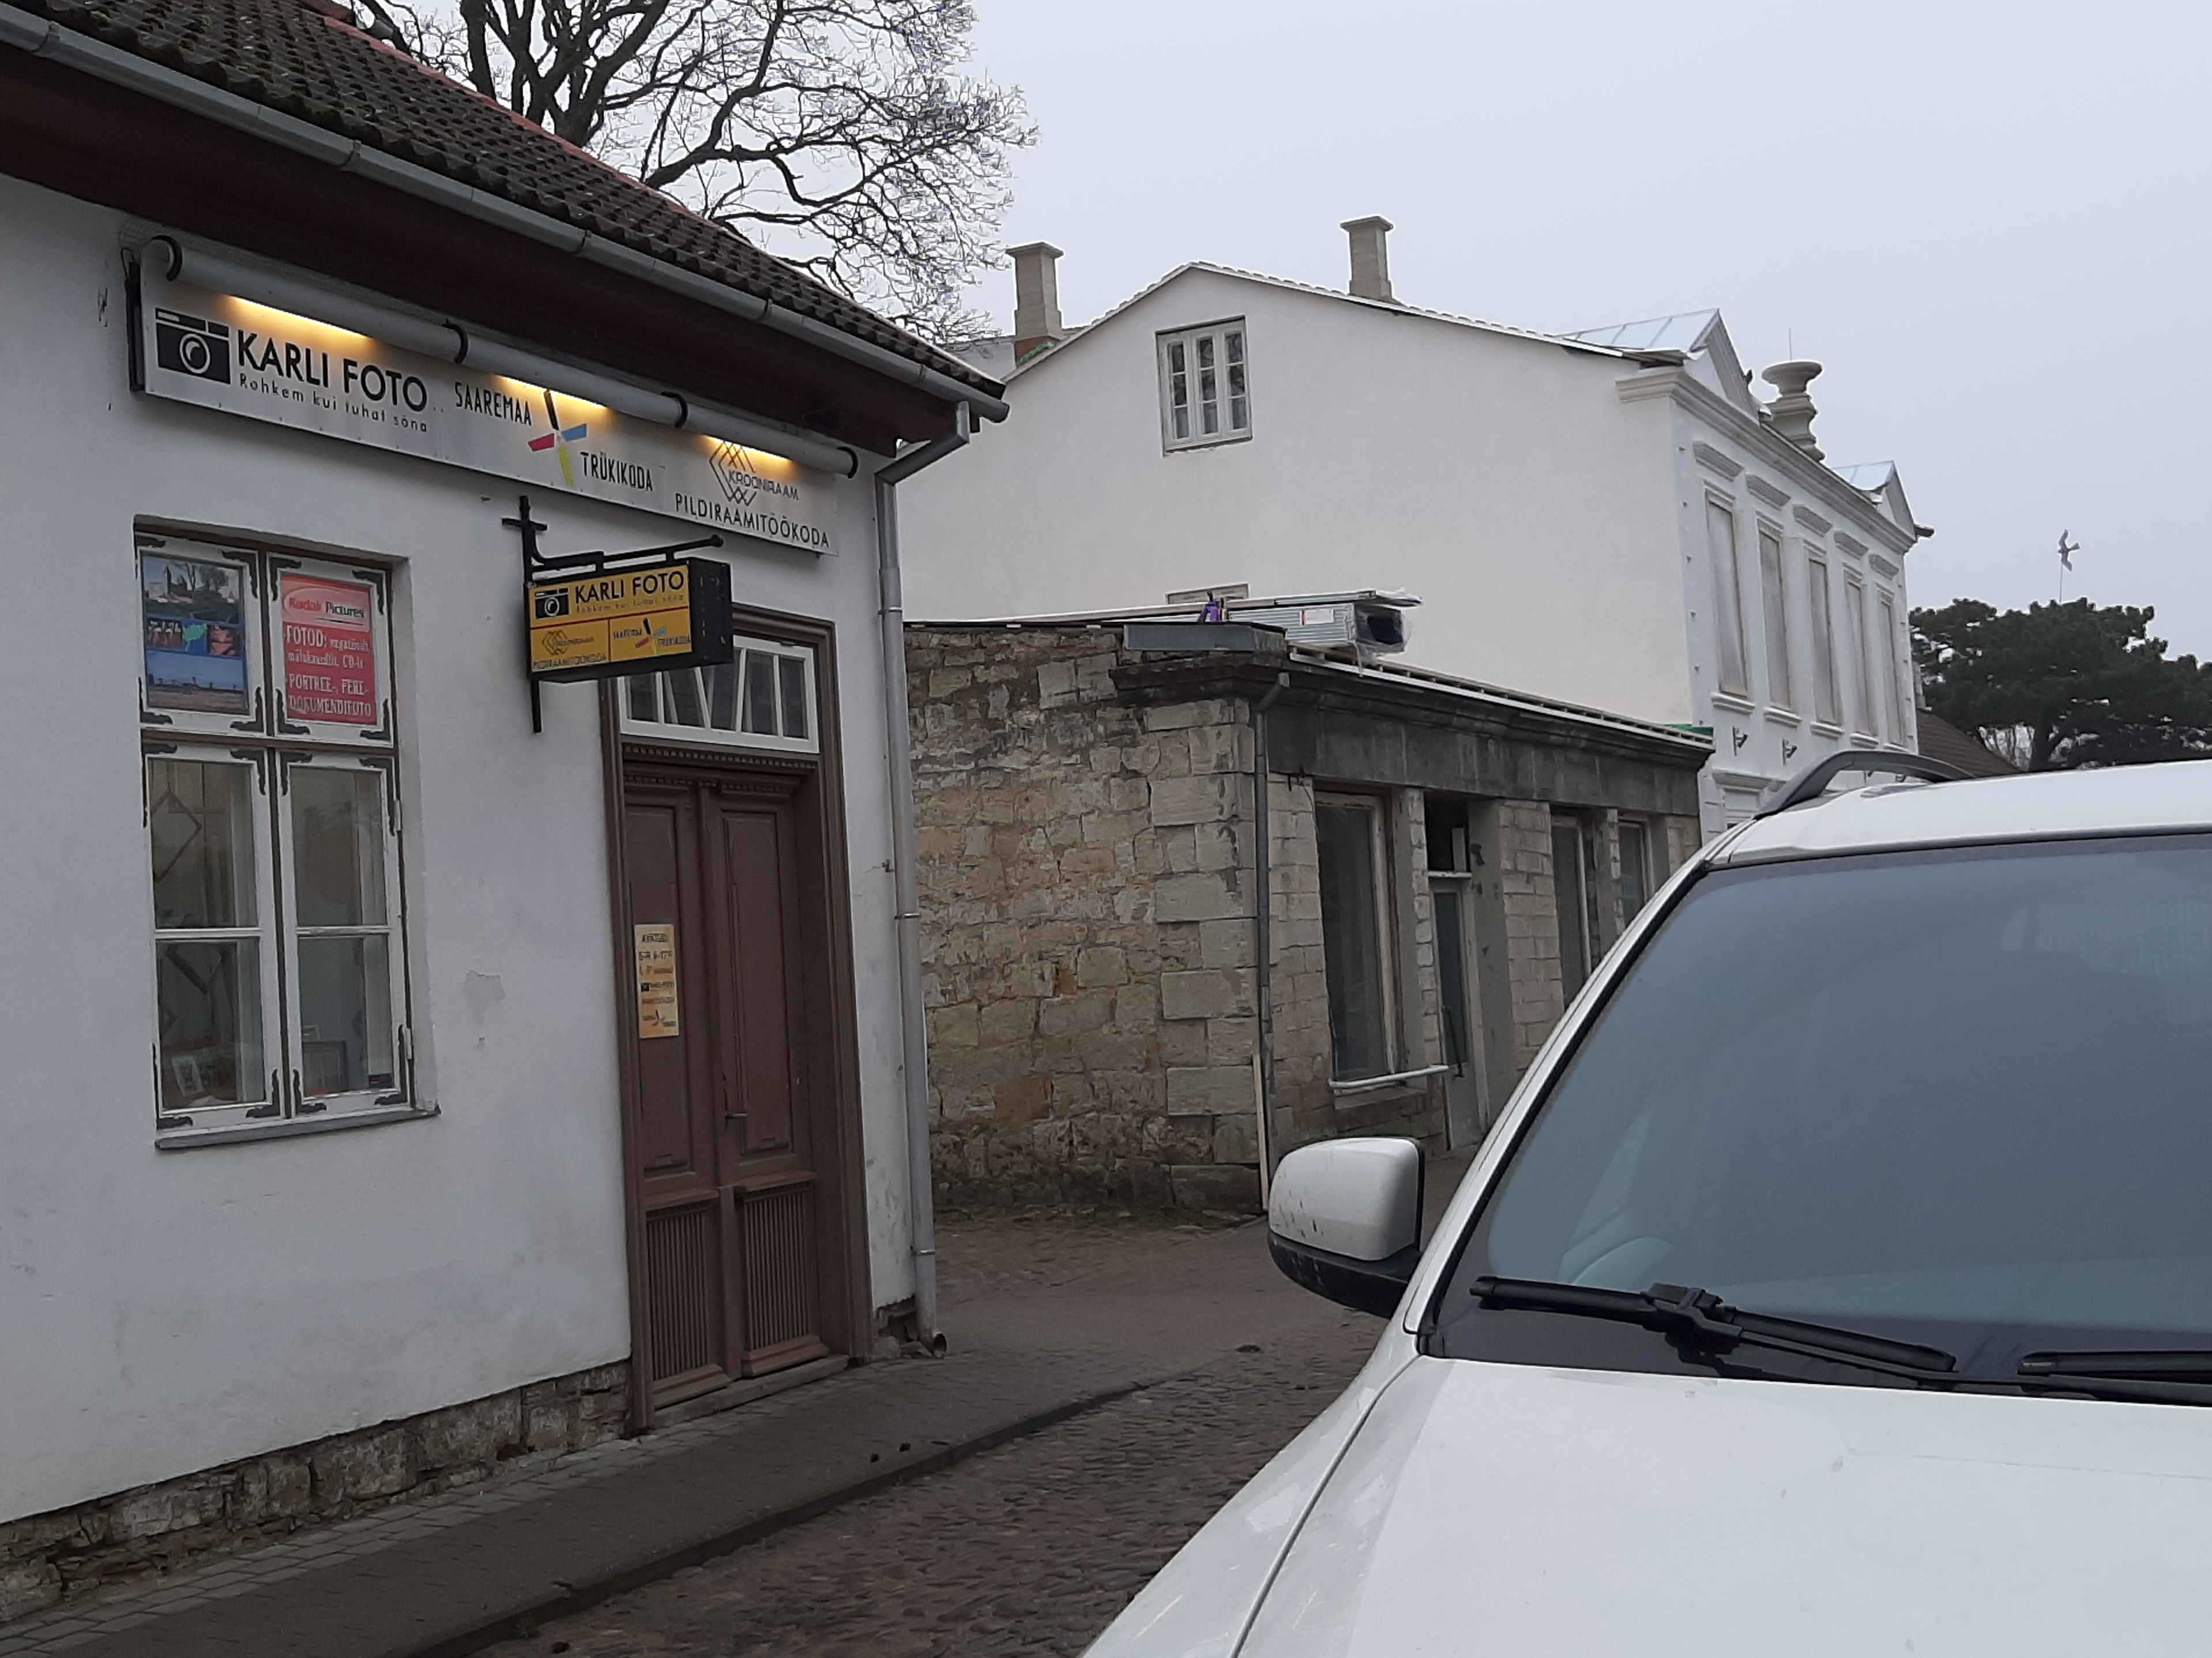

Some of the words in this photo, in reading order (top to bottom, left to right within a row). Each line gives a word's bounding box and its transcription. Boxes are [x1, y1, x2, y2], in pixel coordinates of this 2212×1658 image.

[238, 329, 329, 388] KARLI
[343, 358, 427, 412] FOTO
[239, 373, 304, 402] Rohkem
[313, 391, 337, 410] kui
[345, 402, 385, 422] tuhat
[454, 382, 532, 426] SAAREMAA
[580, 451, 653, 491] TRÜKIKODA
[675, 493, 829, 548] PILDIRAAMITÖÖKODA
[575, 579, 624, 604] KARLI
[633, 571, 684, 596] FOTO
[287, 625, 327, 648] FOTOD:
